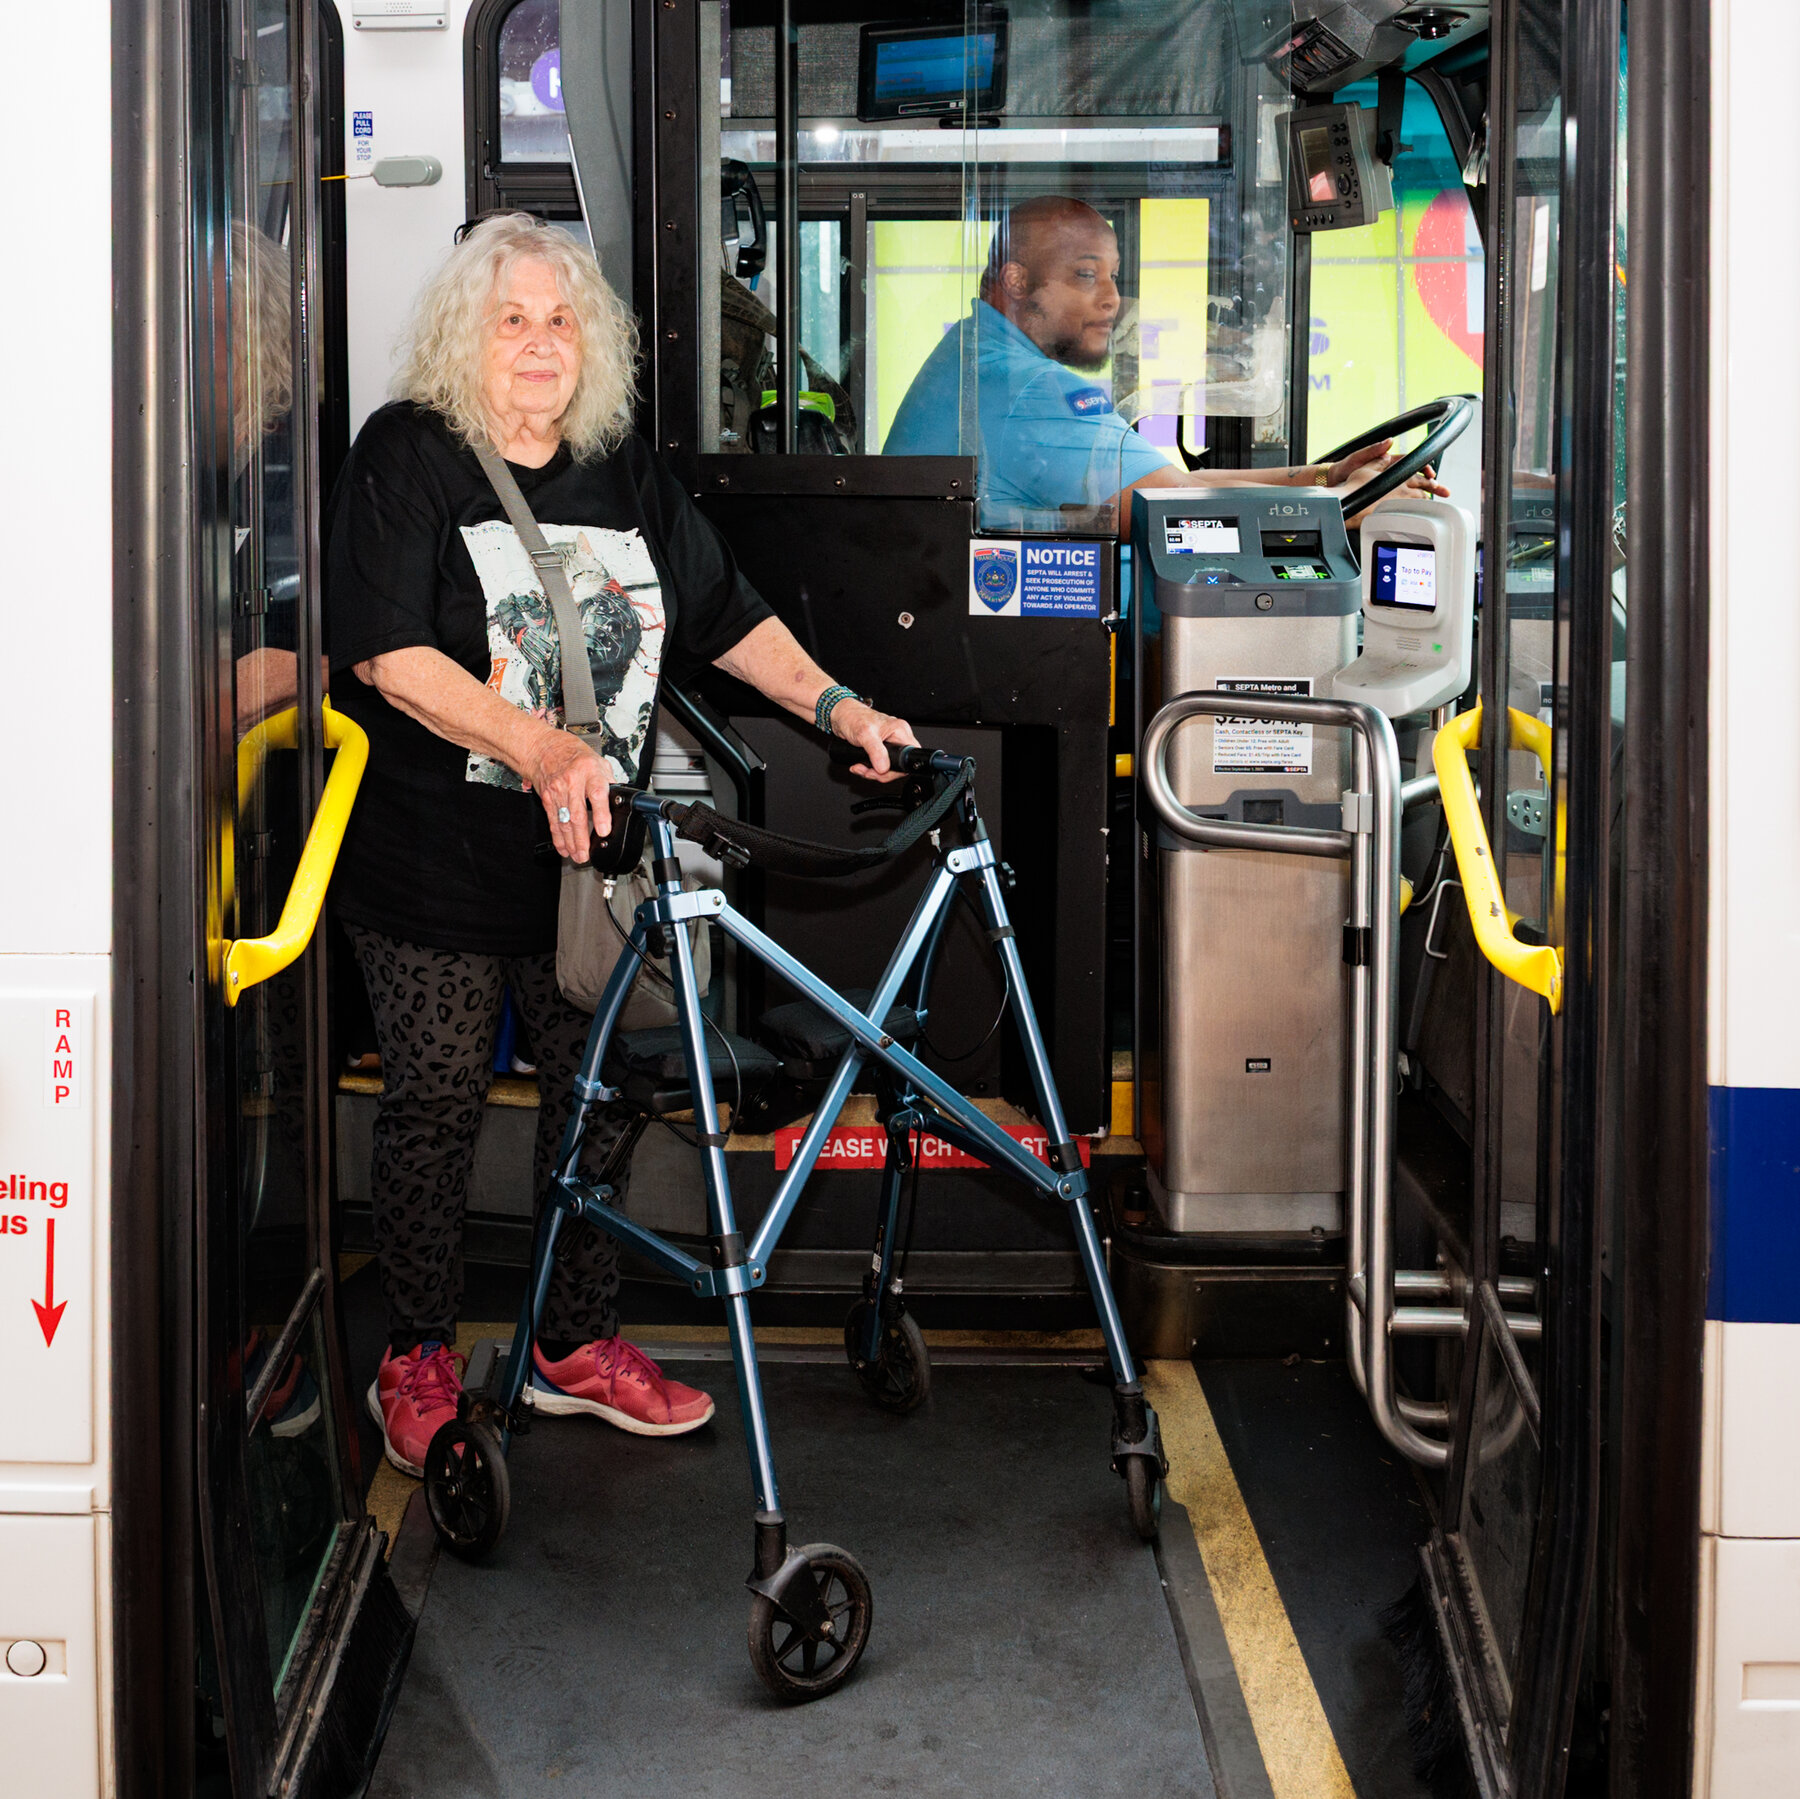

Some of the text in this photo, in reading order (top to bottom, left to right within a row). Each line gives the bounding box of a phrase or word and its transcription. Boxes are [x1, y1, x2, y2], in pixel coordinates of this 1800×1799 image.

[1084, 396, 1108, 407] SEPTA
[1191, 520, 1224, 528] SEPTA
[1026, 548, 1096, 566] NOTICE
[1402, 566, 1412, 574] Tap
[1421, 568, 1433, 576] Pay
[53, 1009, 73, 1104] RAMP
[792, 1138, 874, 1158] PEASE
[877, 1138, 952, 1157] WTCH
